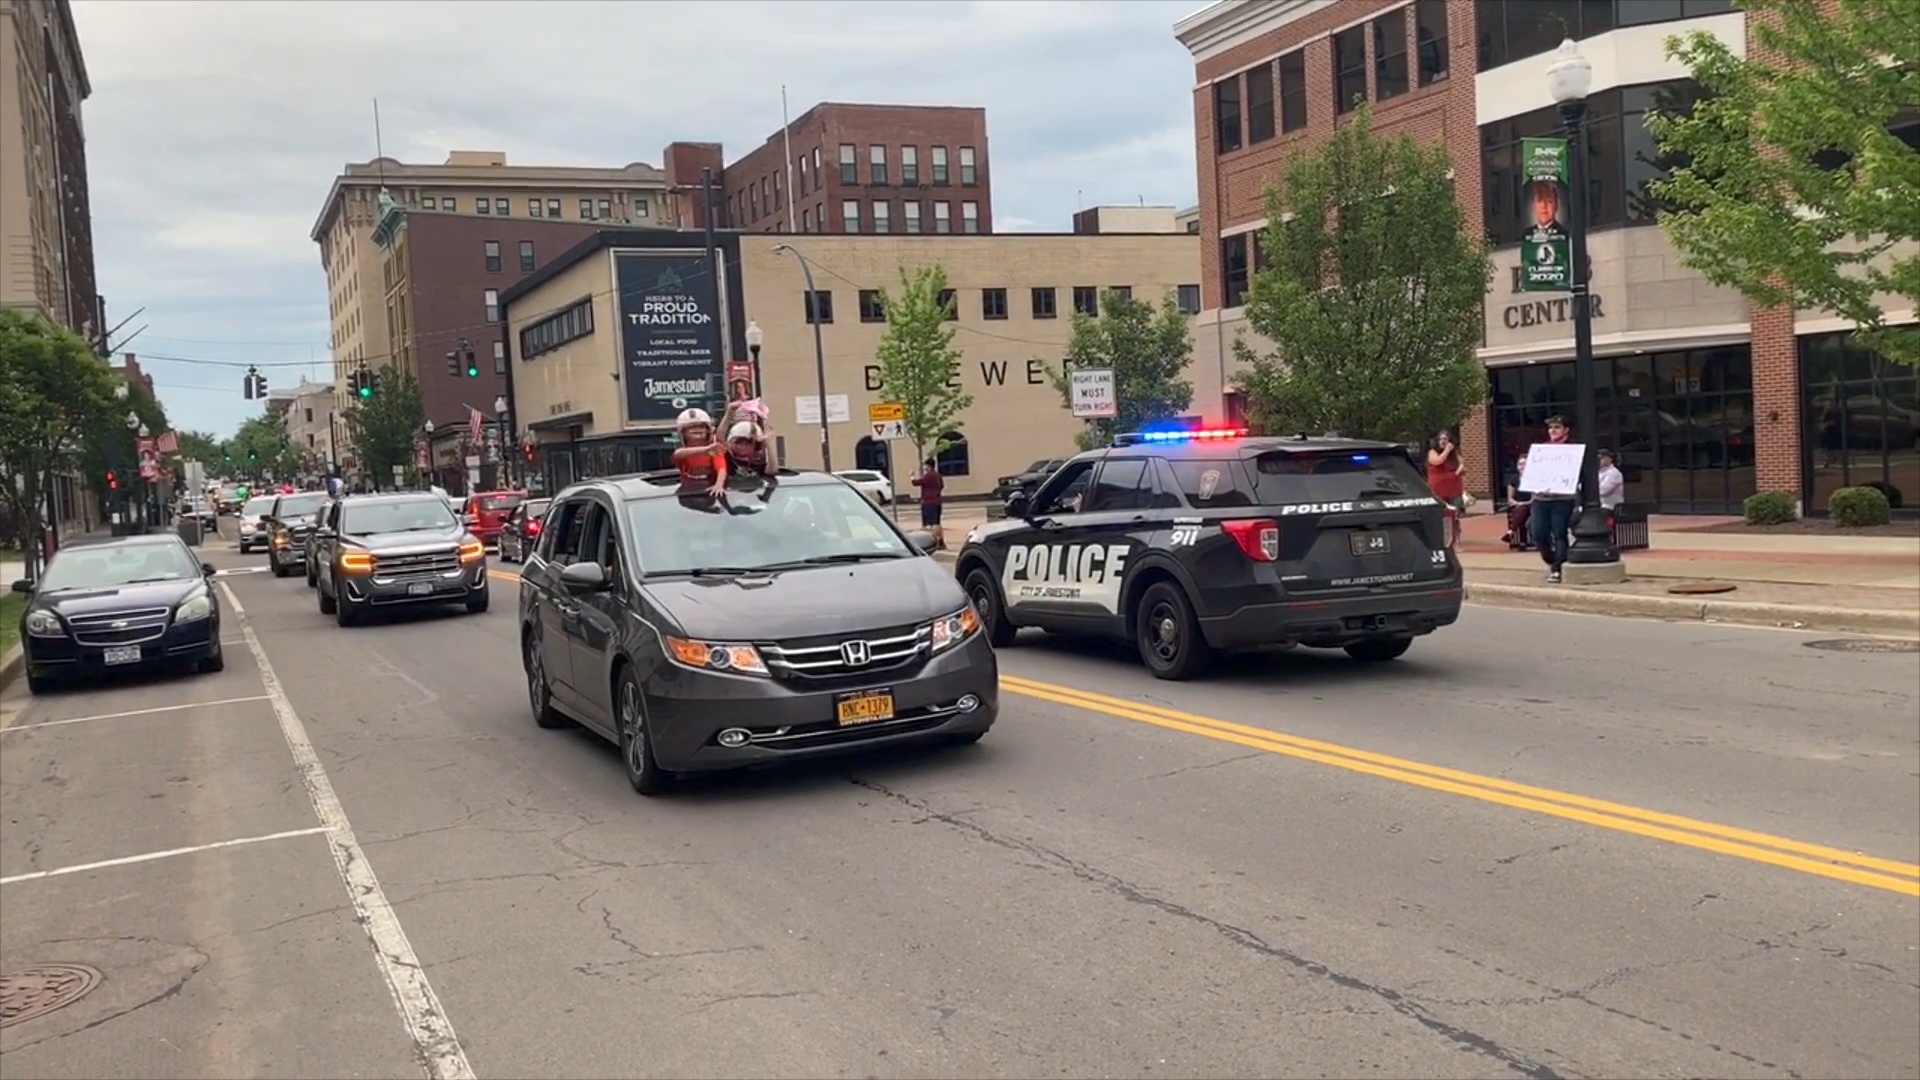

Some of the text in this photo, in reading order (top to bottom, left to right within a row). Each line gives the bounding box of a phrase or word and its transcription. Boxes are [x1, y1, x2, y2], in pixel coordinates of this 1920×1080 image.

[643, 302, 698, 313] PROUD
[1081, 388, 1105, 398] MUST
[1282, 501, 1353, 515] POLICE
[1170, 530, 1198, 546] 911
[1002, 544, 1131, 584] POLICE
